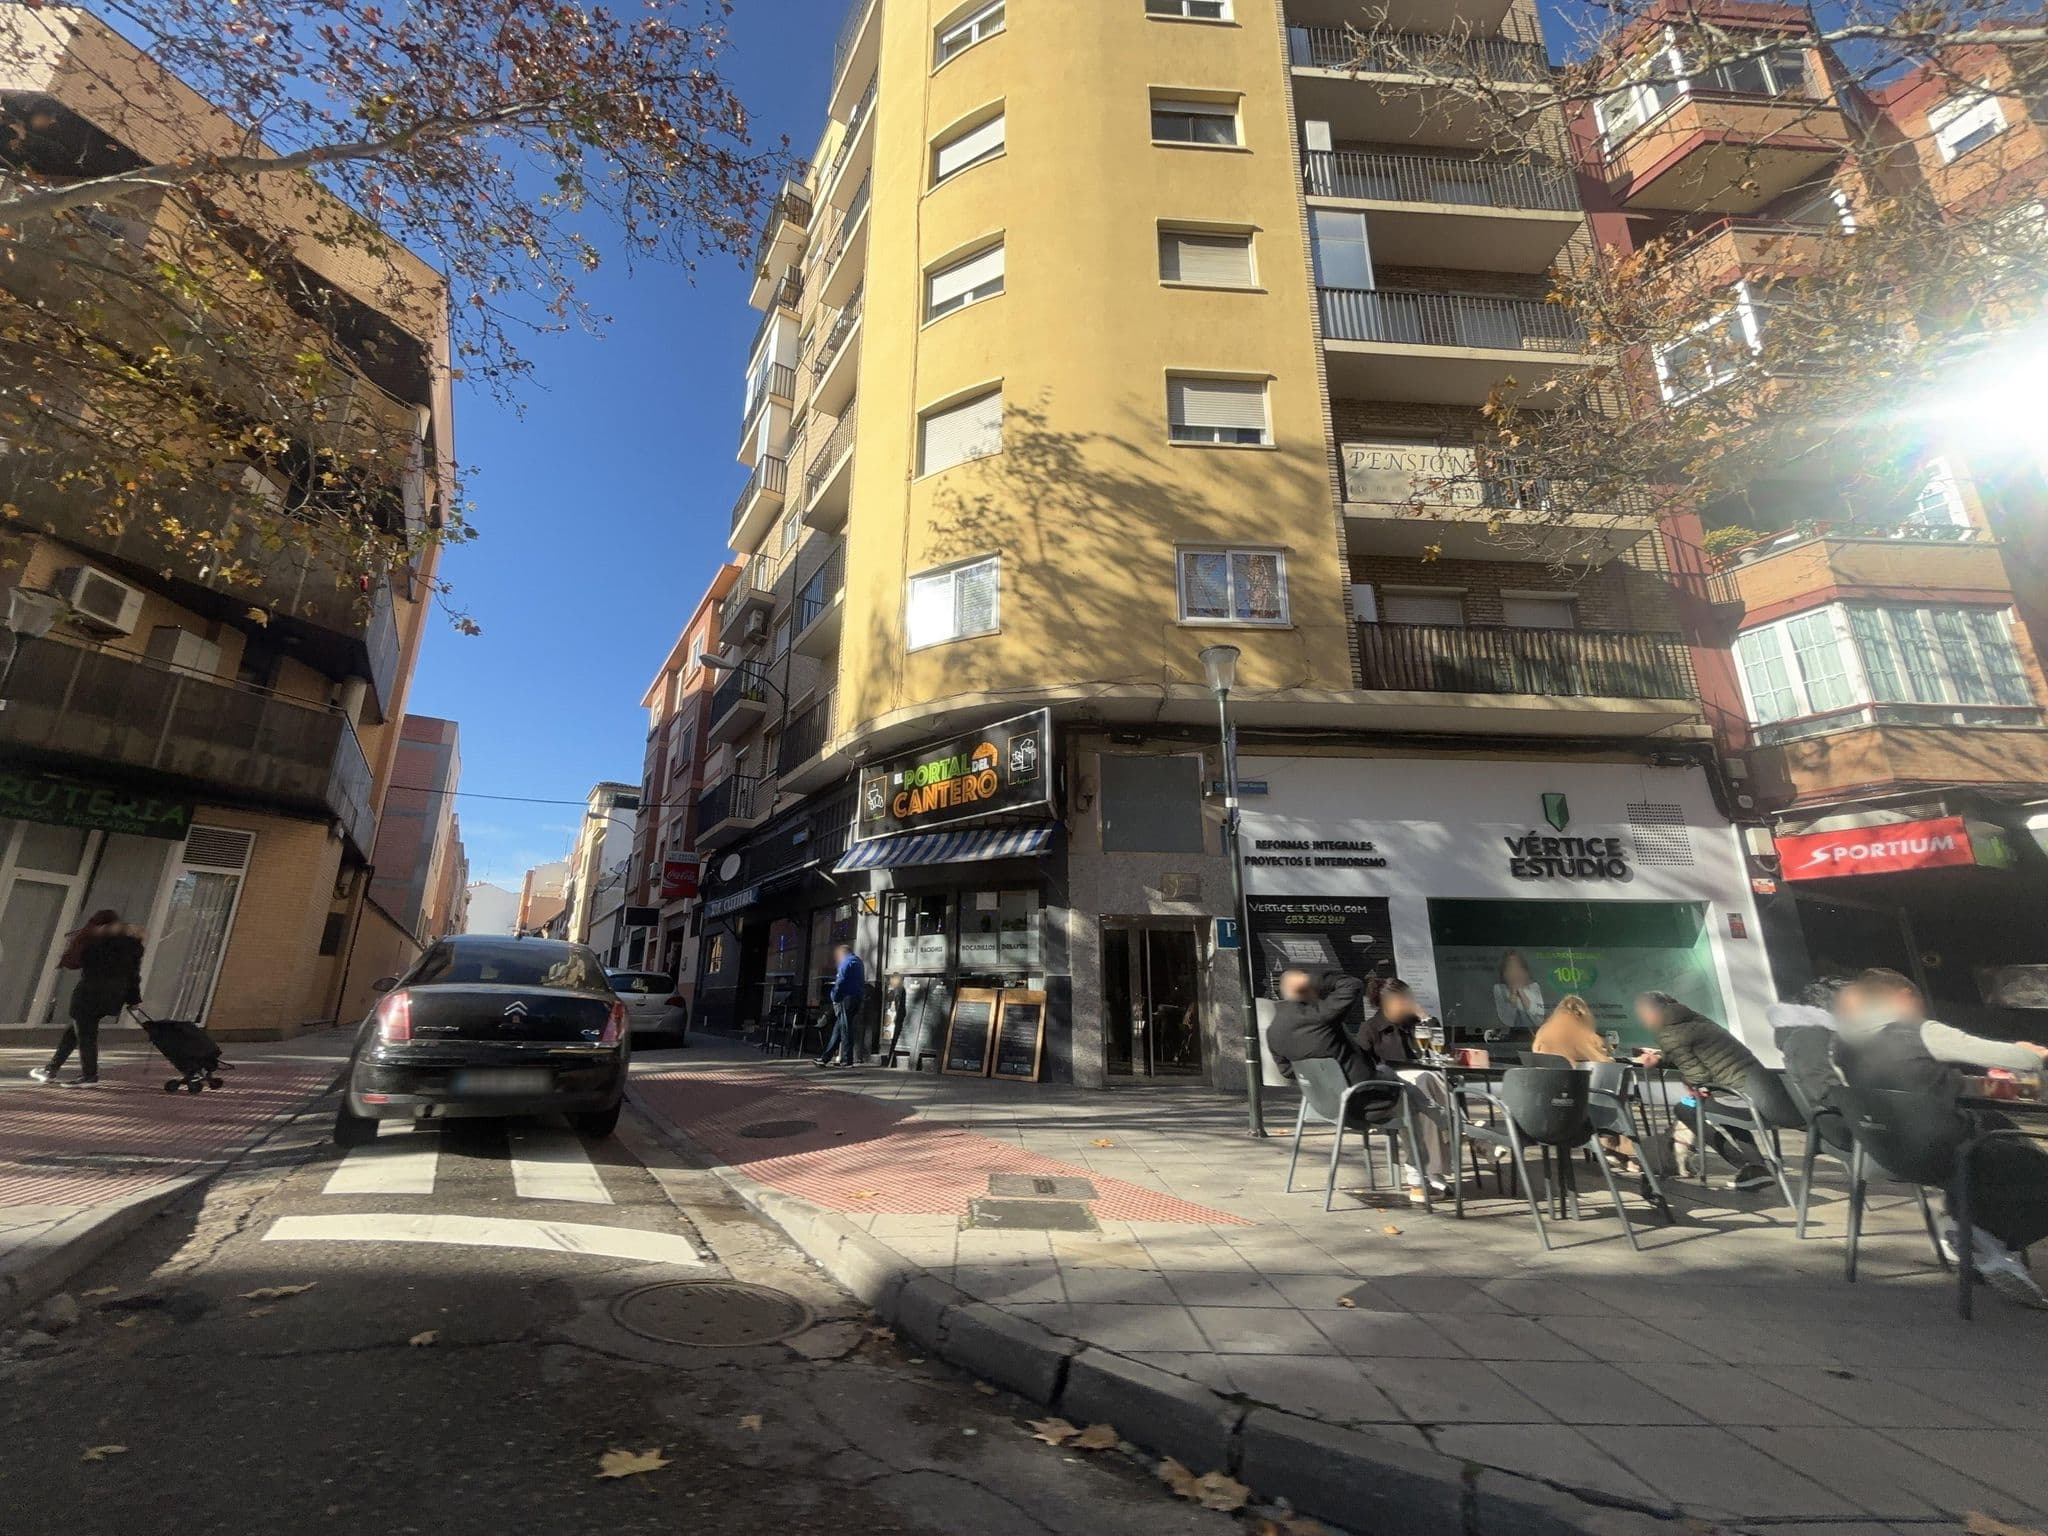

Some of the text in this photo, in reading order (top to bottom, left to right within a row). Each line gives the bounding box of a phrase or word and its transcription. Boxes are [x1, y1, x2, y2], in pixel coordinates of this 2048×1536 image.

[904, 752, 972, 791] PORTAL
[972, 757, 990, 773] DEL
[892, 769, 998, 819] CANTERO
[1255, 840, 1373, 851] REFORMAS INTEGRALES
[1504, 830, 1624, 857] VÉRTICE
[1796, 835, 1955, 871] SPORTIUM
[1244, 856, 1387, 868] PROYECTOS E INTERIORISMO
[1510, 858, 1627, 879] ESTUDIO
[1225, 921, 1237, 938] P
